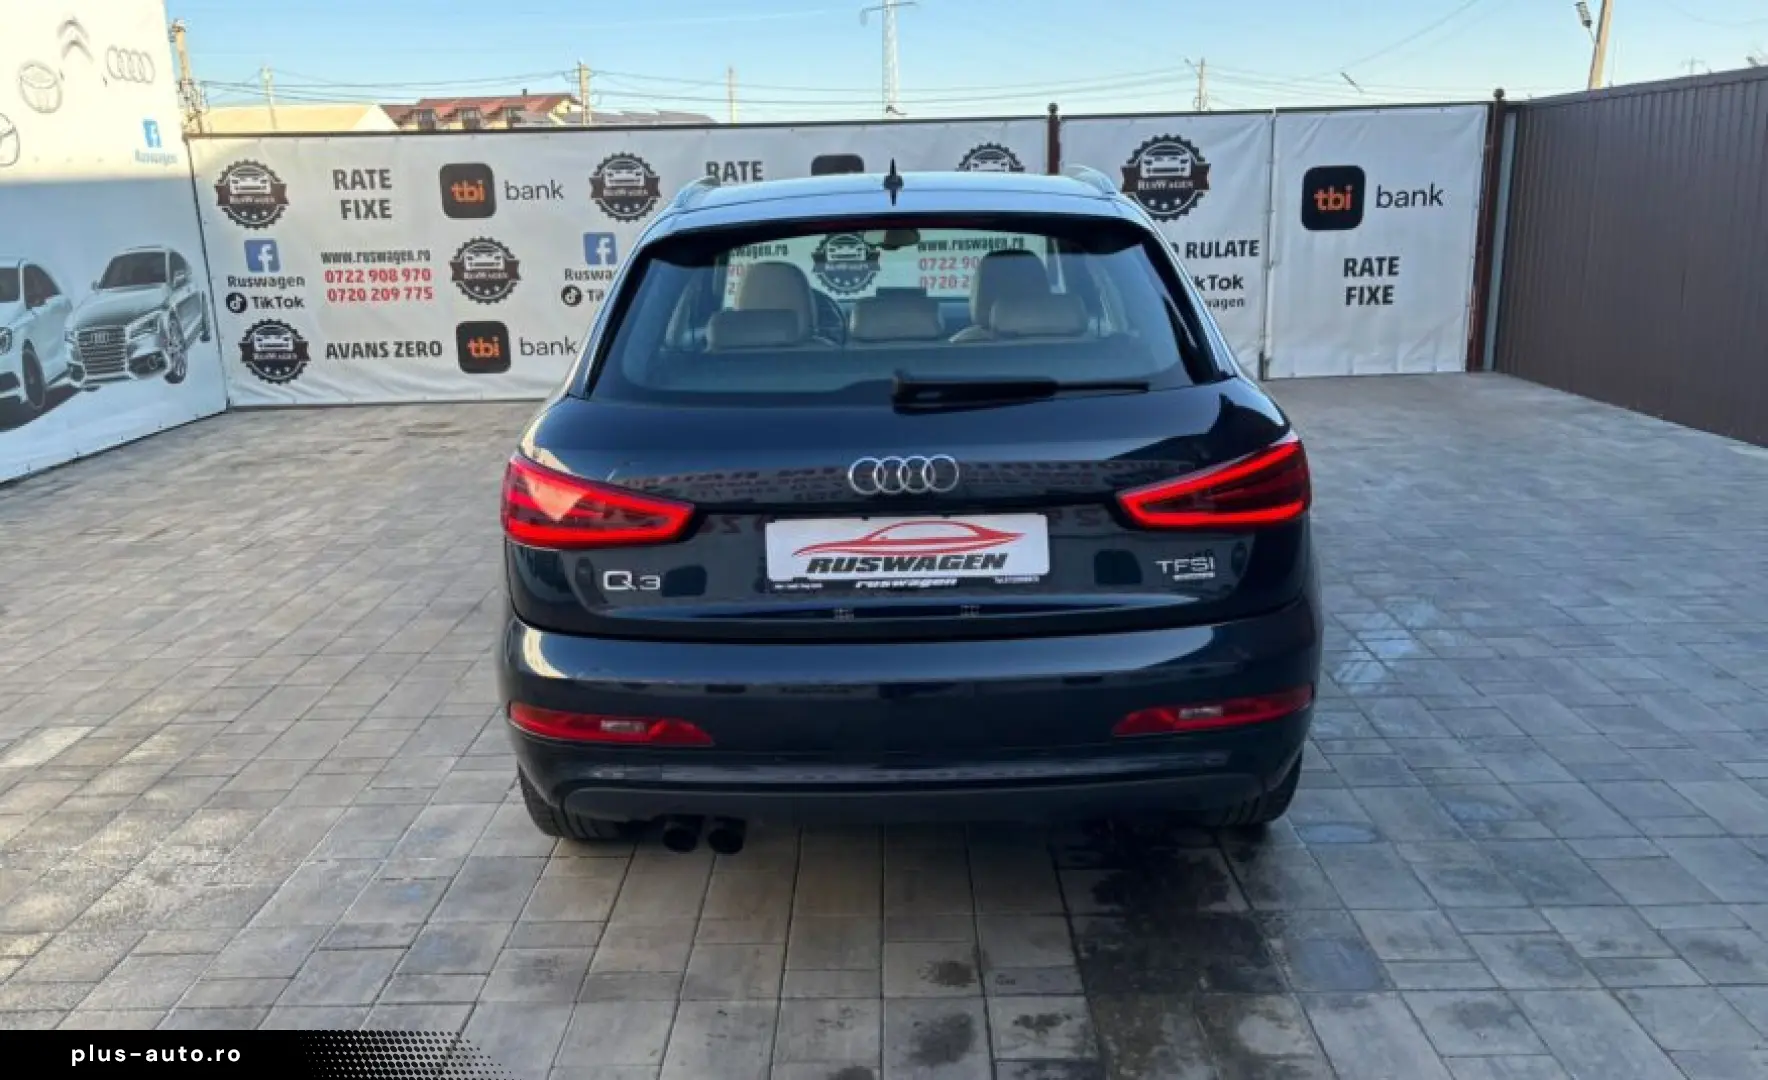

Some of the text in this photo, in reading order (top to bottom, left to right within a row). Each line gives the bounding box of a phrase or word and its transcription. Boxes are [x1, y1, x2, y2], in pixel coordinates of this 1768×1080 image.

[332, 169, 393, 191] RATE
[706, 160, 763, 182] RATE
[451, 179, 565, 203] tbi bank
[1313, 181, 1444, 212] tbi bank
[340, 199, 393, 220] FIXE
[320, 250, 431, 265] www.ruswagen.ro
[1185, 239, 1260, 259] RULATE
[919, 255, 980, 272] 0722 90
[1343, 256, 1400, 278] RATE
[227, 275, 306, 290] Ruswagen
[325, 267, 432, 283] 0722 908 970
[564, 268, 617, 281] Ruswa
[1192, 274, 1244, 291] kTok
[251, 295, 305, 309] TikTok
[326, 286, 433, 302] 0720 209 775
[1345, 285, 1395, 306] FIXE
[1205, 298, 1244, 311] wagen
[326, 340, 443, 360] AVANS ZERO
[467, 335, 578, 359] tbi bank
[806, 552, 1008, 574] RUSWAGEN
[1154, 556, 1216, 574] TFSI
[603, 570, 661, 591] Q3
